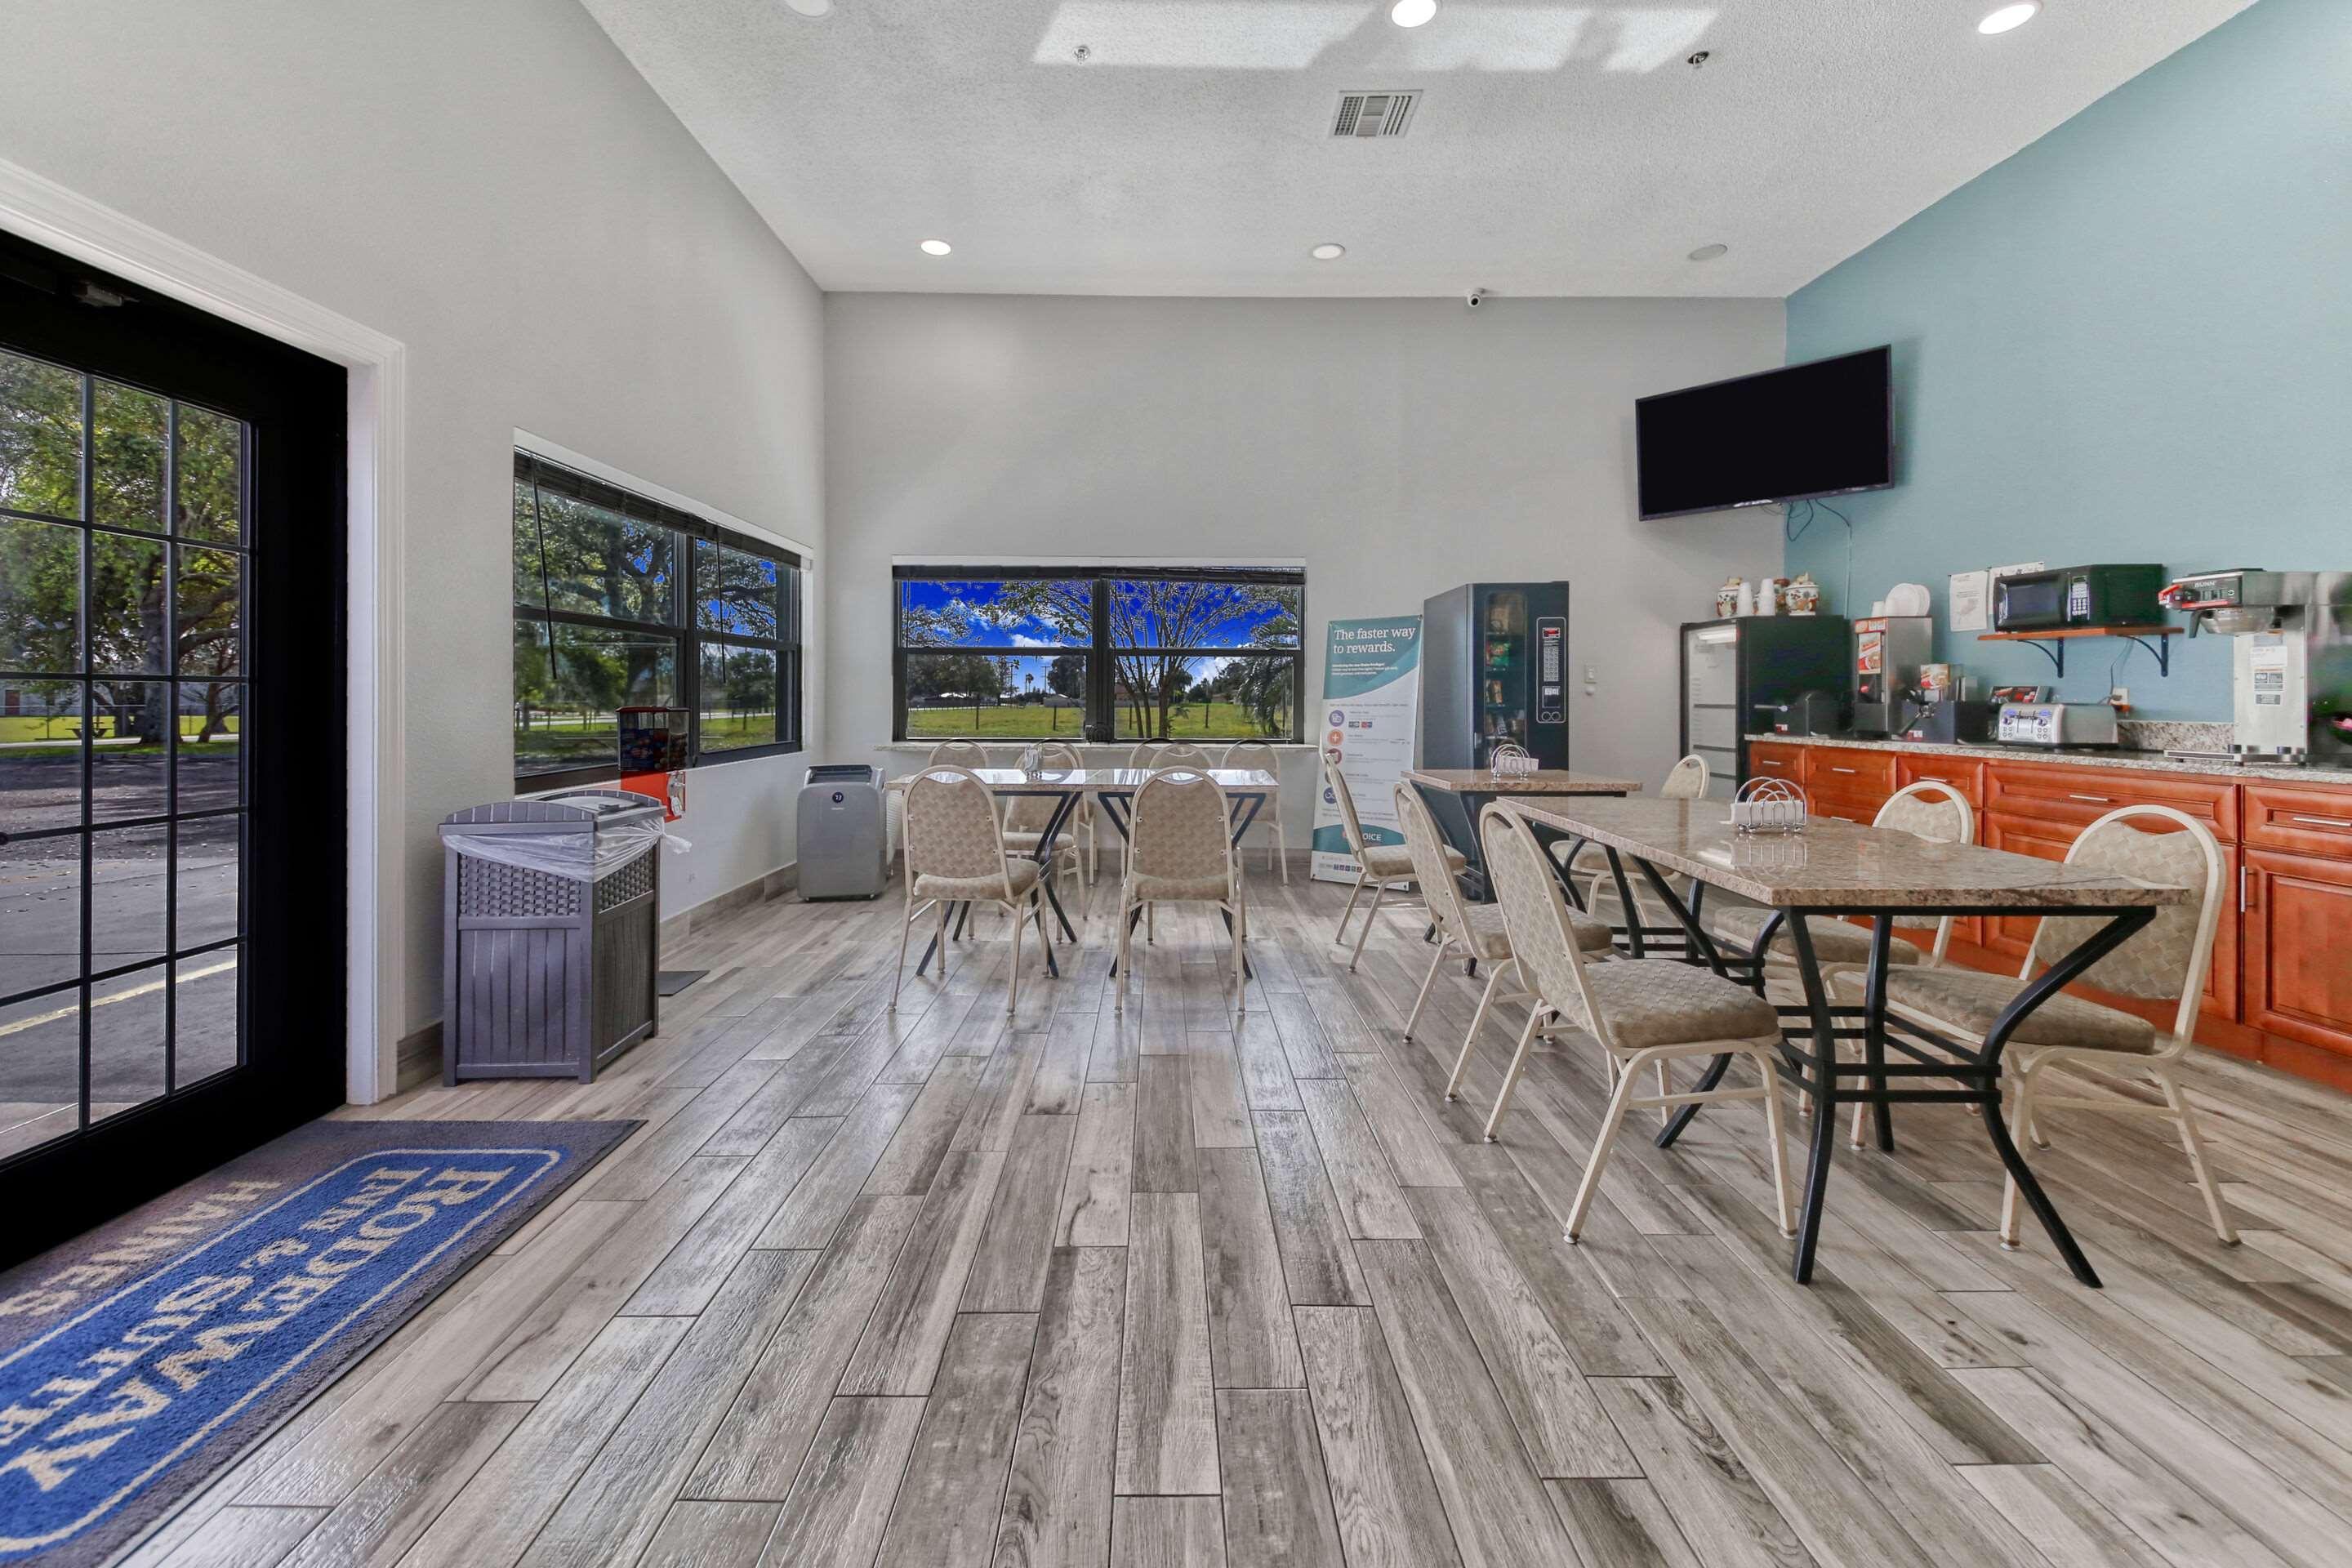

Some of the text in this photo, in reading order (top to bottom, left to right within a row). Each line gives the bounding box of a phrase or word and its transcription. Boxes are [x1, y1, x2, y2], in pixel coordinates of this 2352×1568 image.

[1334, 627, 1416, 640] The faster way
[1333, 641, 1396, 654] to rewards.
[1363, 833, 1382, 841] OICE
[0, 1181, 283, 1316] HAINES
[240, 1236, 310, 1268] &
[0, 1166, 516, 1491] RODEWAY
